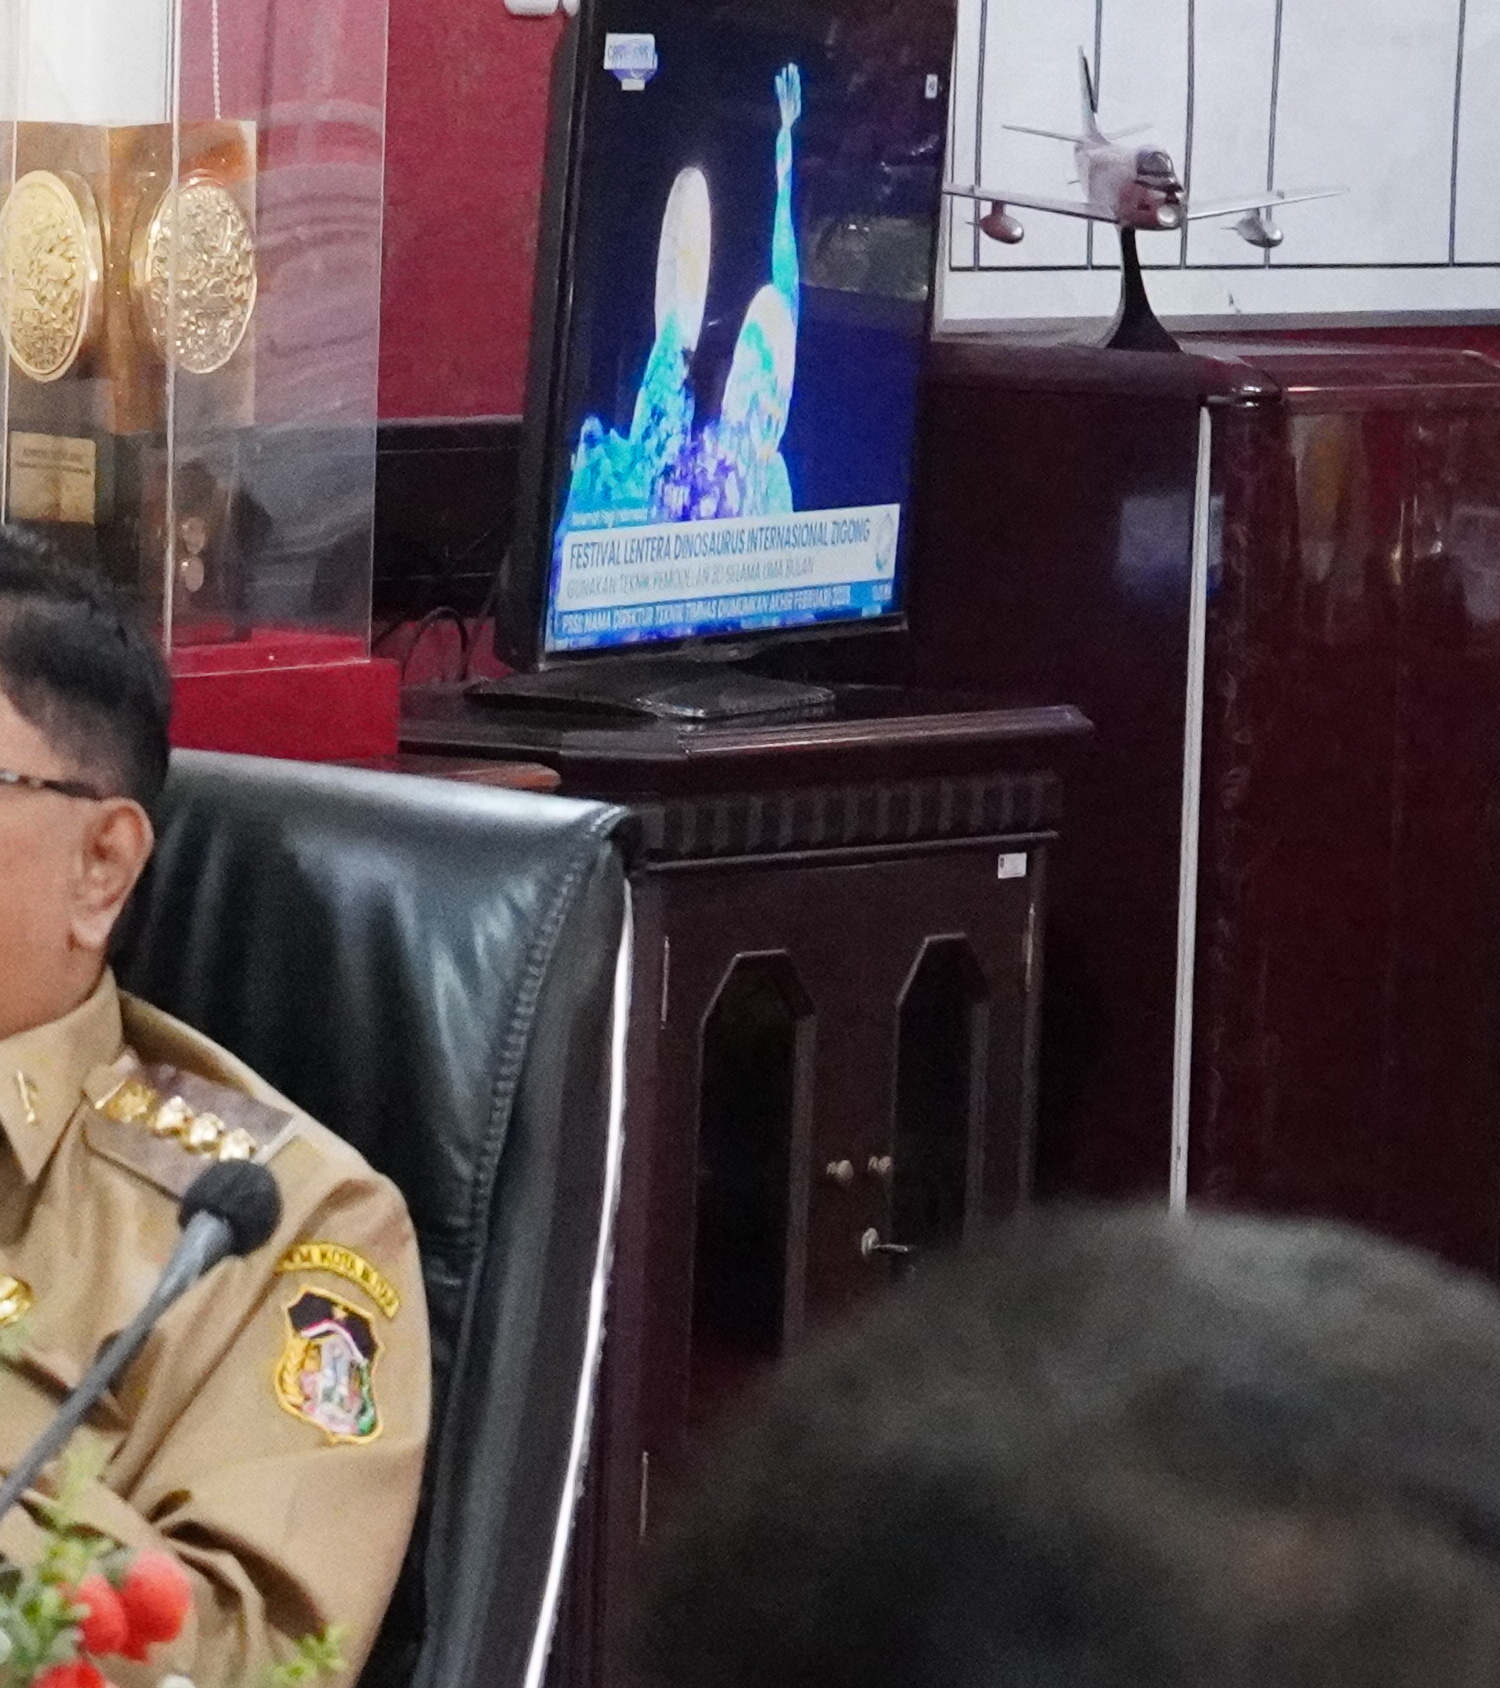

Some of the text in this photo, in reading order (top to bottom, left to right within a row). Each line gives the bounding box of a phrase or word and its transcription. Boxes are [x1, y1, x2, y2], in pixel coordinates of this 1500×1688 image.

[567, 516, 871, 571] FESTIVAL LENTERA DINOSAURUS INTERNASIONAL ZIGONG
